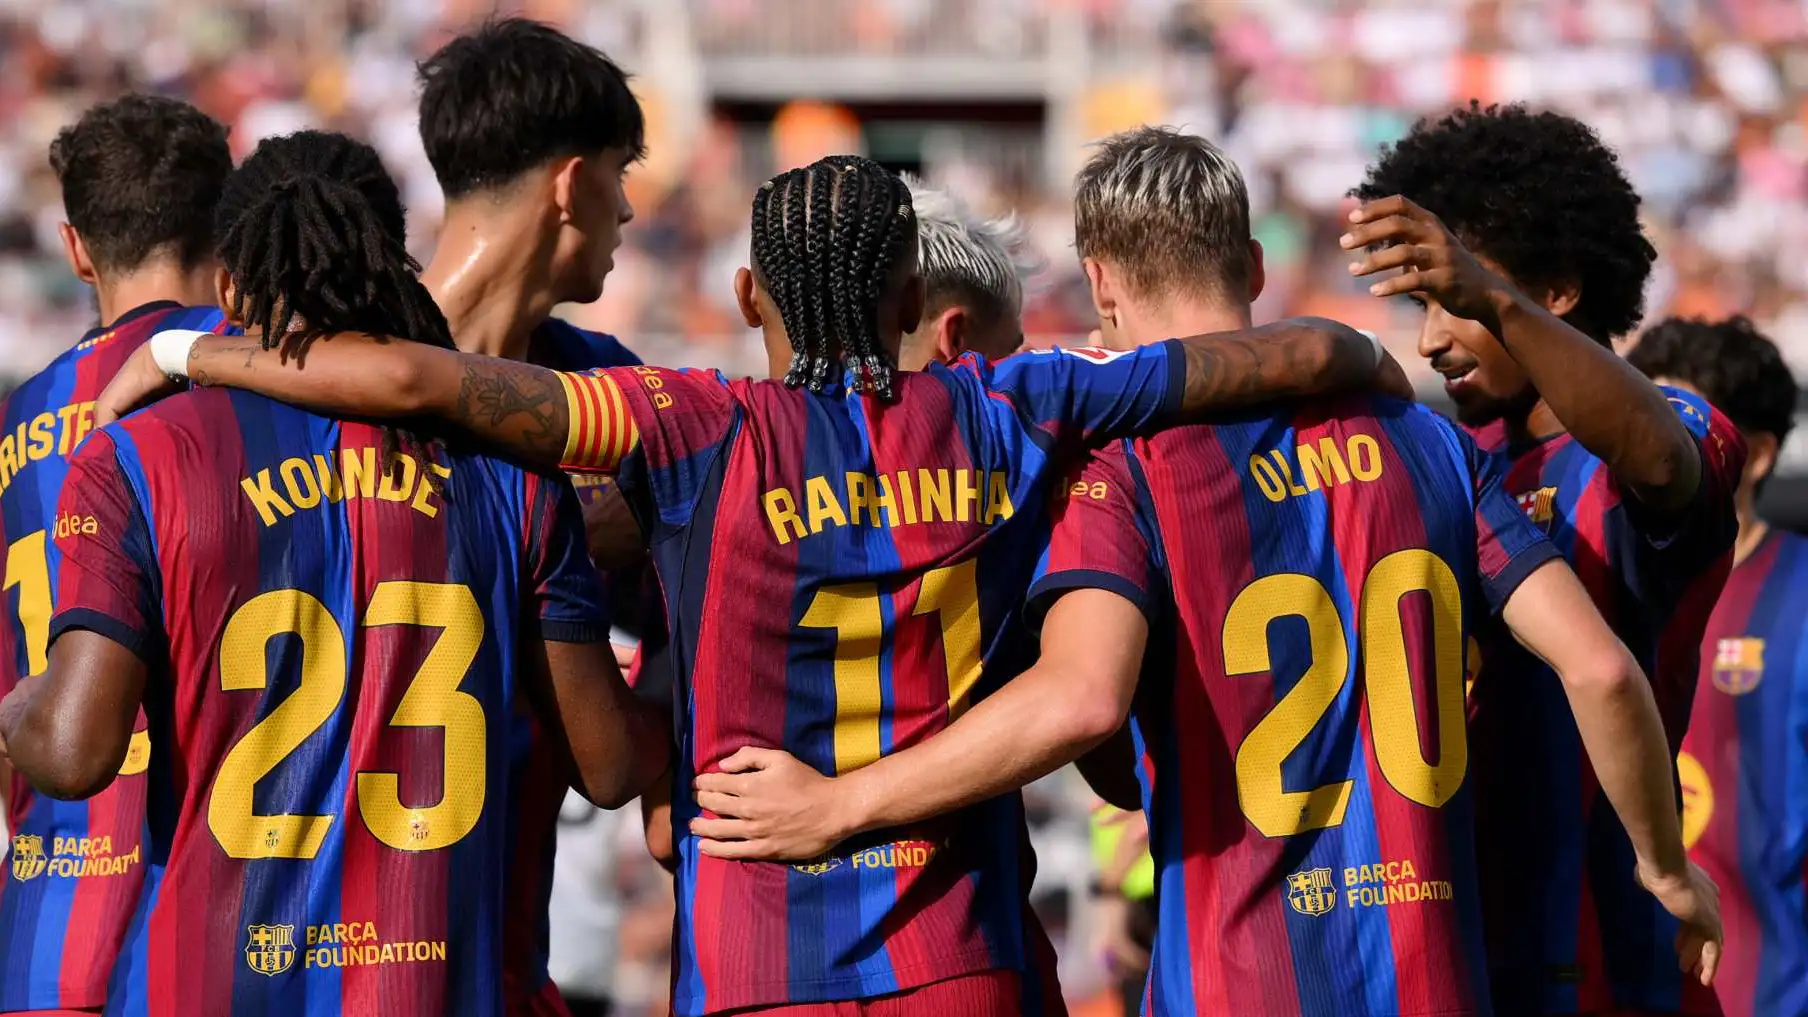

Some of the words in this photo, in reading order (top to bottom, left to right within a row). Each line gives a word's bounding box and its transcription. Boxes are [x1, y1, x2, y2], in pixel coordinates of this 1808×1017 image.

[1249, 434, 1383, 502] OLMO
[52, 510, 98, 539] idea
[763, 468, 1015, 545] RAPHINHA
[798, 557, 984, 777] 11
[1222, 548, 1468, 838] 20
[208, 581, 487, 859] 23
[53, 835, 112, 859] BARÇA
[1344, 860, 1417, 886] BARÇA
[305, 941, 446, 969] FOUNDATION
[306, 921, 378, 945] BARÇA
